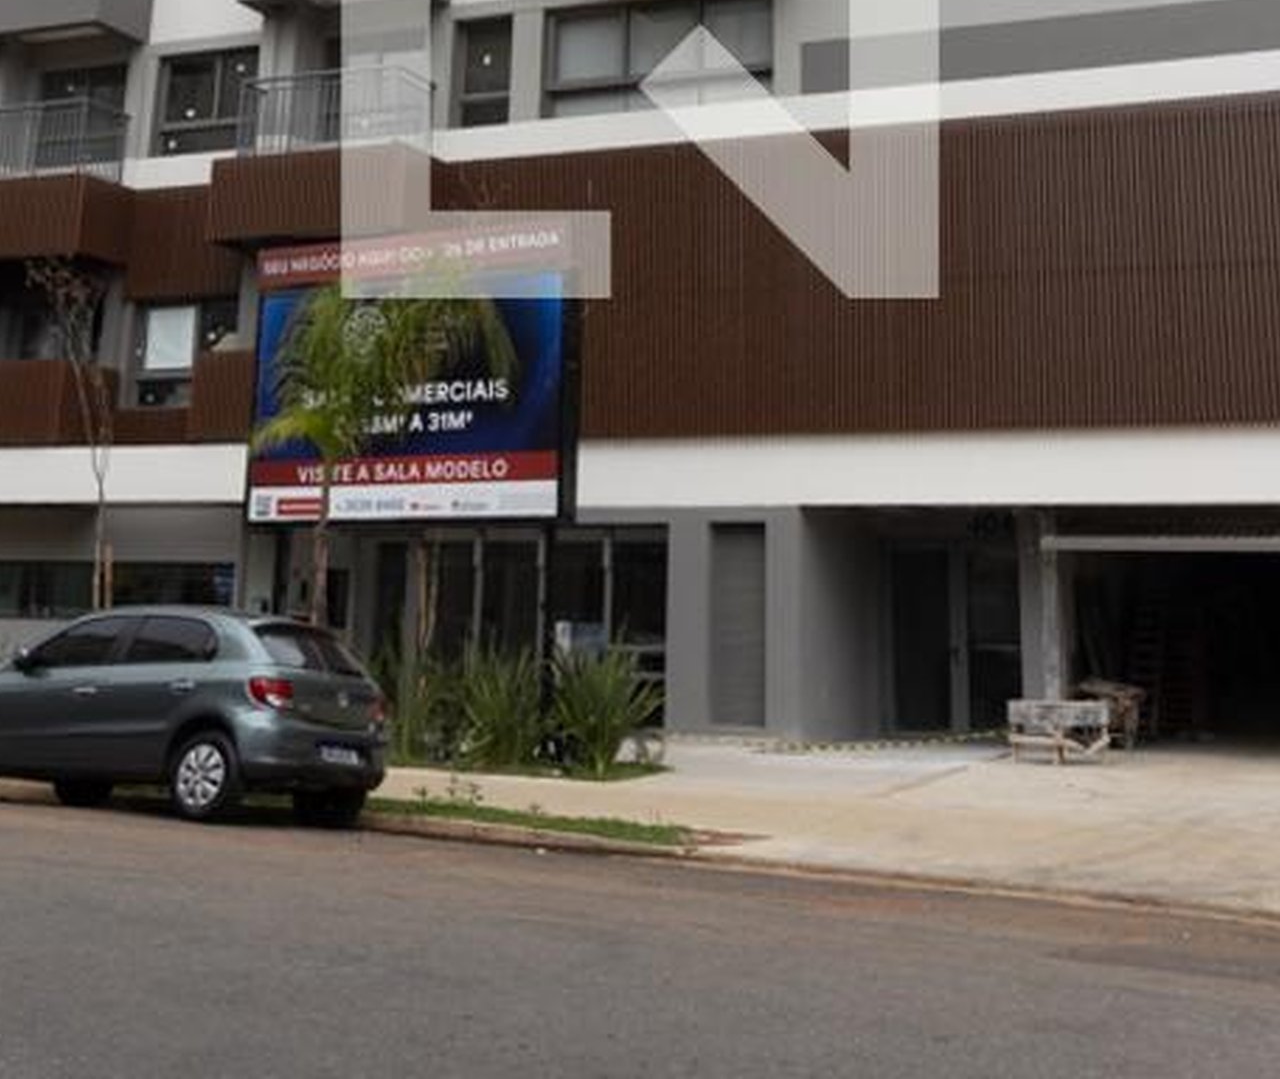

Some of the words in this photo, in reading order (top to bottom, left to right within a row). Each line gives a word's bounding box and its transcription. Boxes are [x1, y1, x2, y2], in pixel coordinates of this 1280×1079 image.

[264, 258, 288, 275] SEU
[290, 251, 355, 271] NEGÓCIO
[489, 230, 559, 252] ENTRADA
[409, 415, 424, 432] A
[297, 464, 353, 483] VISTE
[356, 464, 369, 482] A
[373, 463, 419, 481] SALA
[425, 459, 508, 479] MODELO
